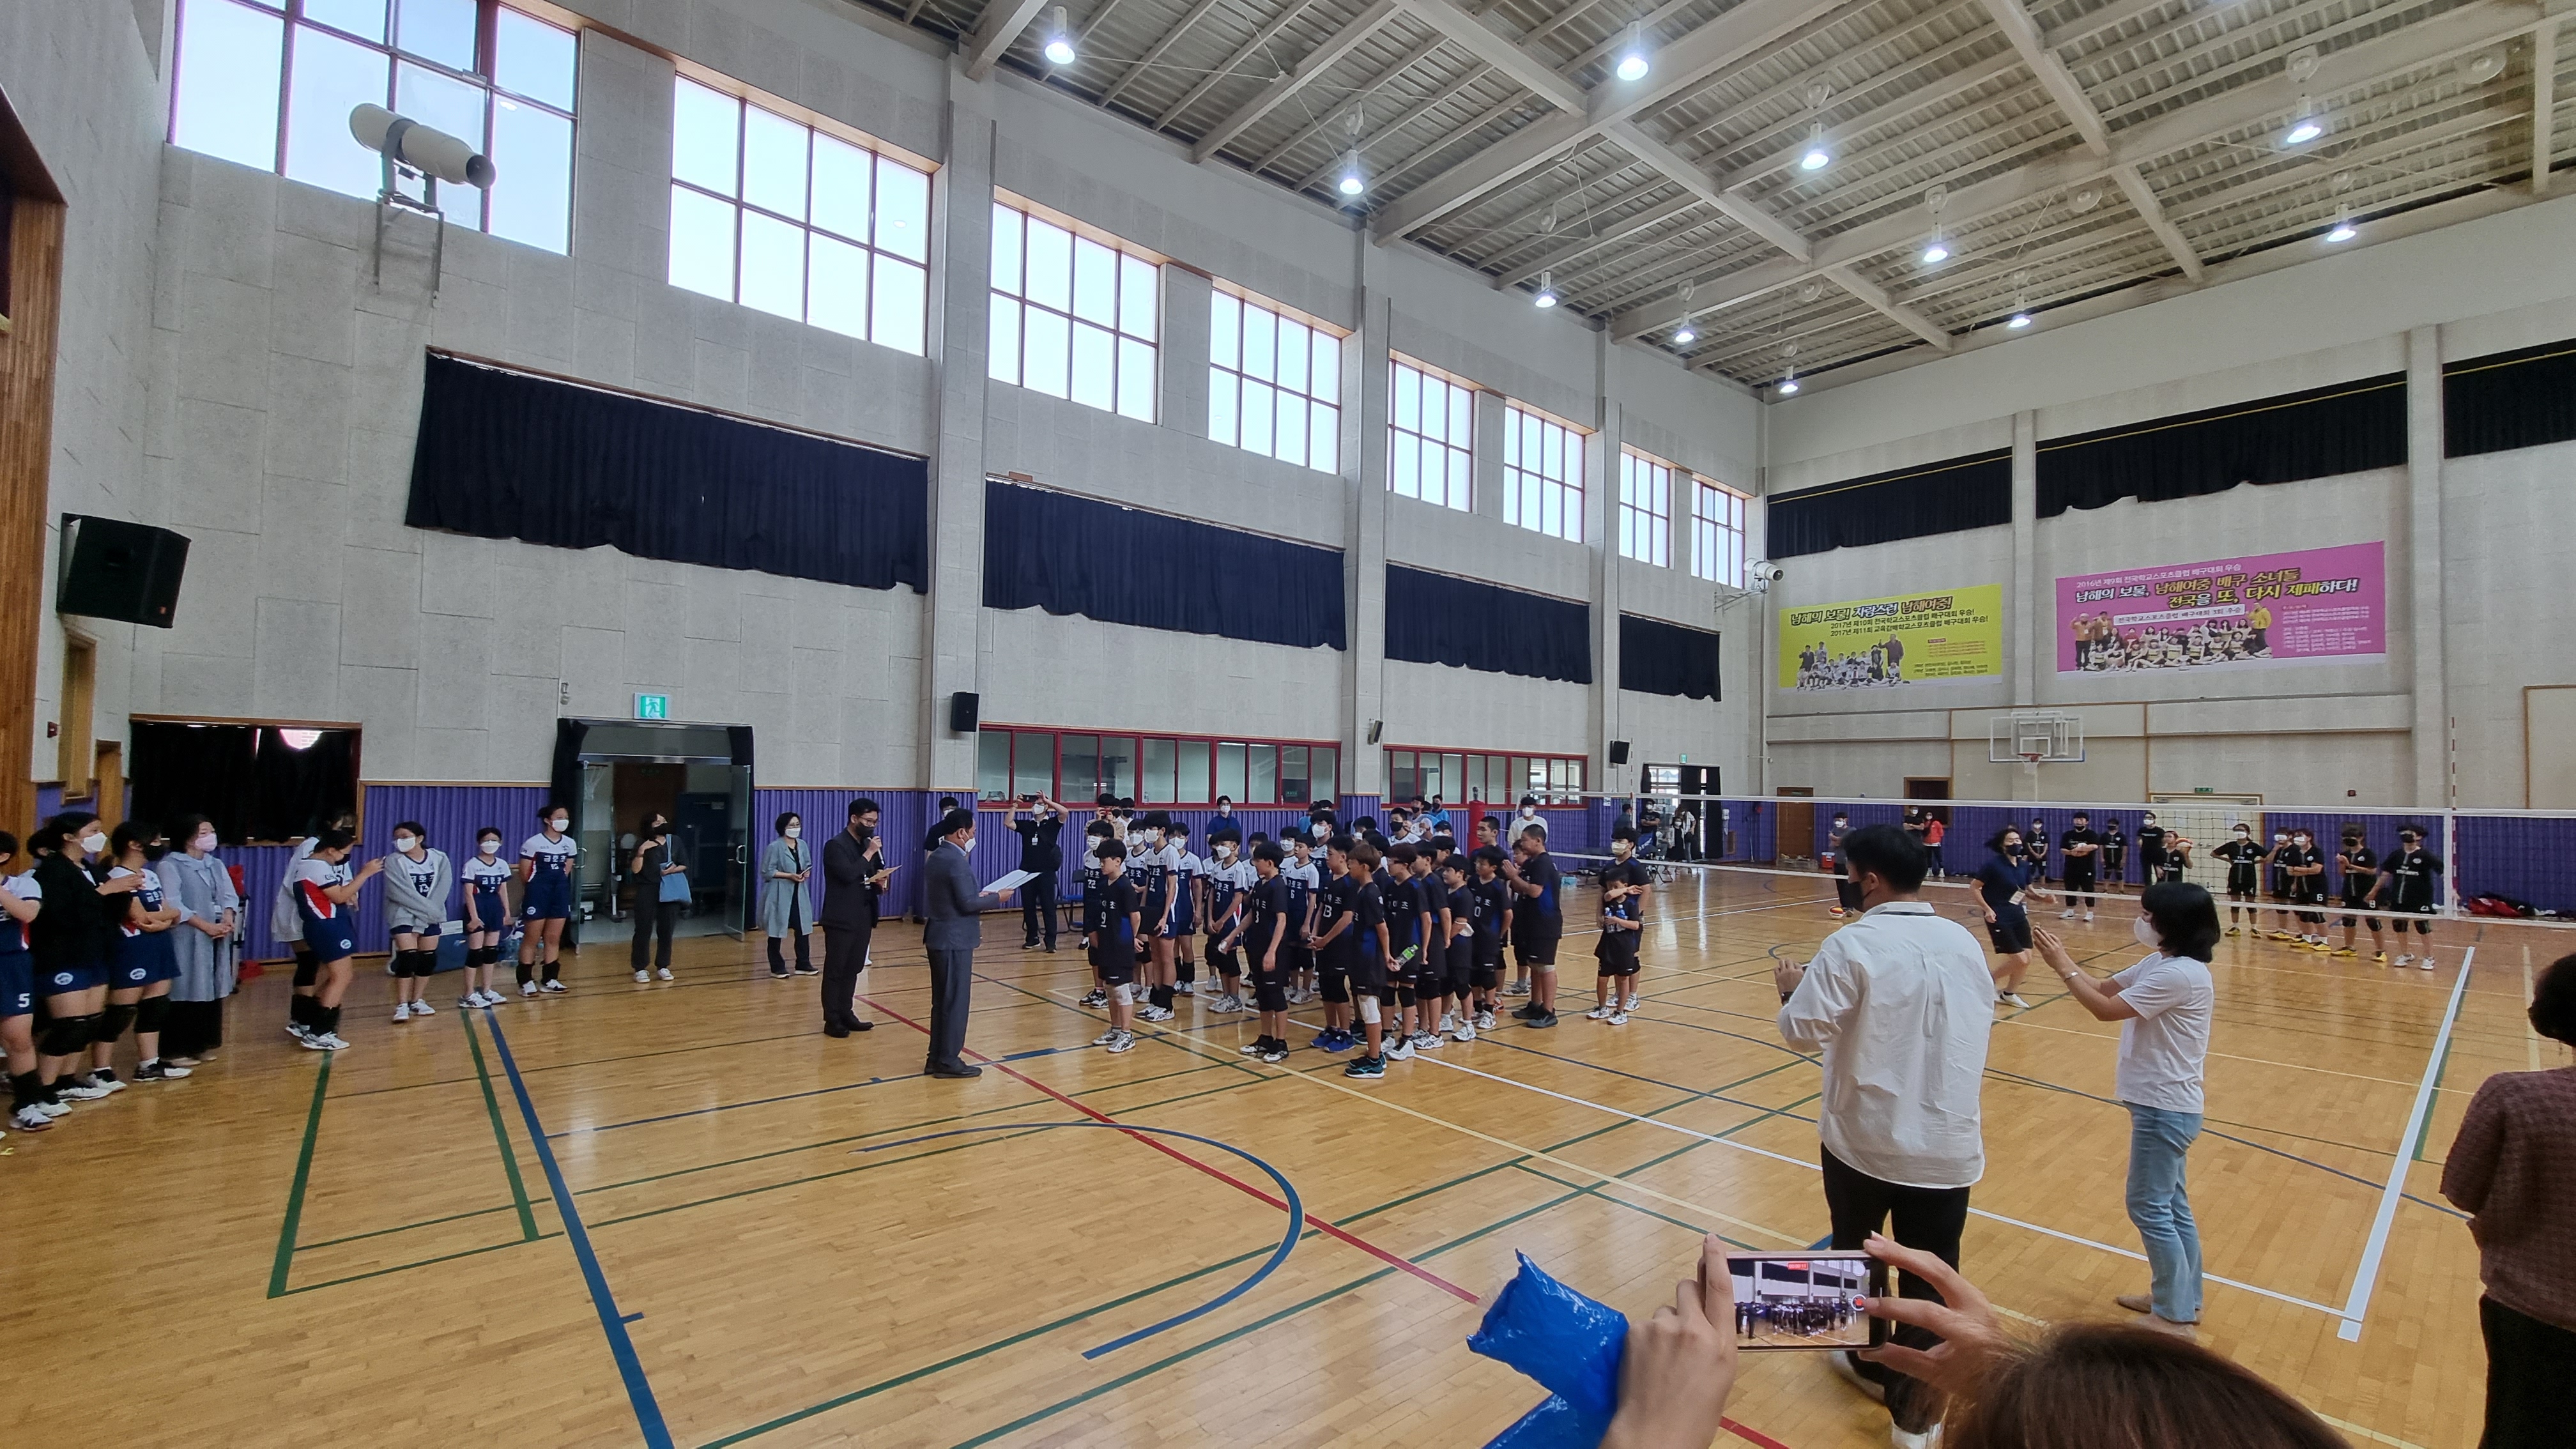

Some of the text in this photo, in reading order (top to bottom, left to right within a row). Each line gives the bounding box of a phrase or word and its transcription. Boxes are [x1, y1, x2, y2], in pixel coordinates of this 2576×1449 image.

[2076, 564, 2241, 588] 2016년 제9회 전국학교스포츠클럽 배구대회 우승
[2076, 567, 2301, 603] 남해의 보물, 남해여중 배구 소녀들
[2168, 578, 2359, 609] 전국을 또, 다시 제패하다!
[1791, 596, 1953, 627] 남해의 보물! 자랑스런 남해여중!
[1831, 620, 1851, 629] 2017년
[1853, 617, 1873, 627] 제10회
[1931, 610, 1958, 619] 배구대회
[1959, 608, 1975, 617] 우승!
[1830, 627, 1851, 637] 2017년
[1853, 625, 1873, 635] 제11회
[1944, 617, 1970, 625] 배구대회
[1972, 615, 1988, 624] 우승!
[17, 993, 31, 1008] 5
